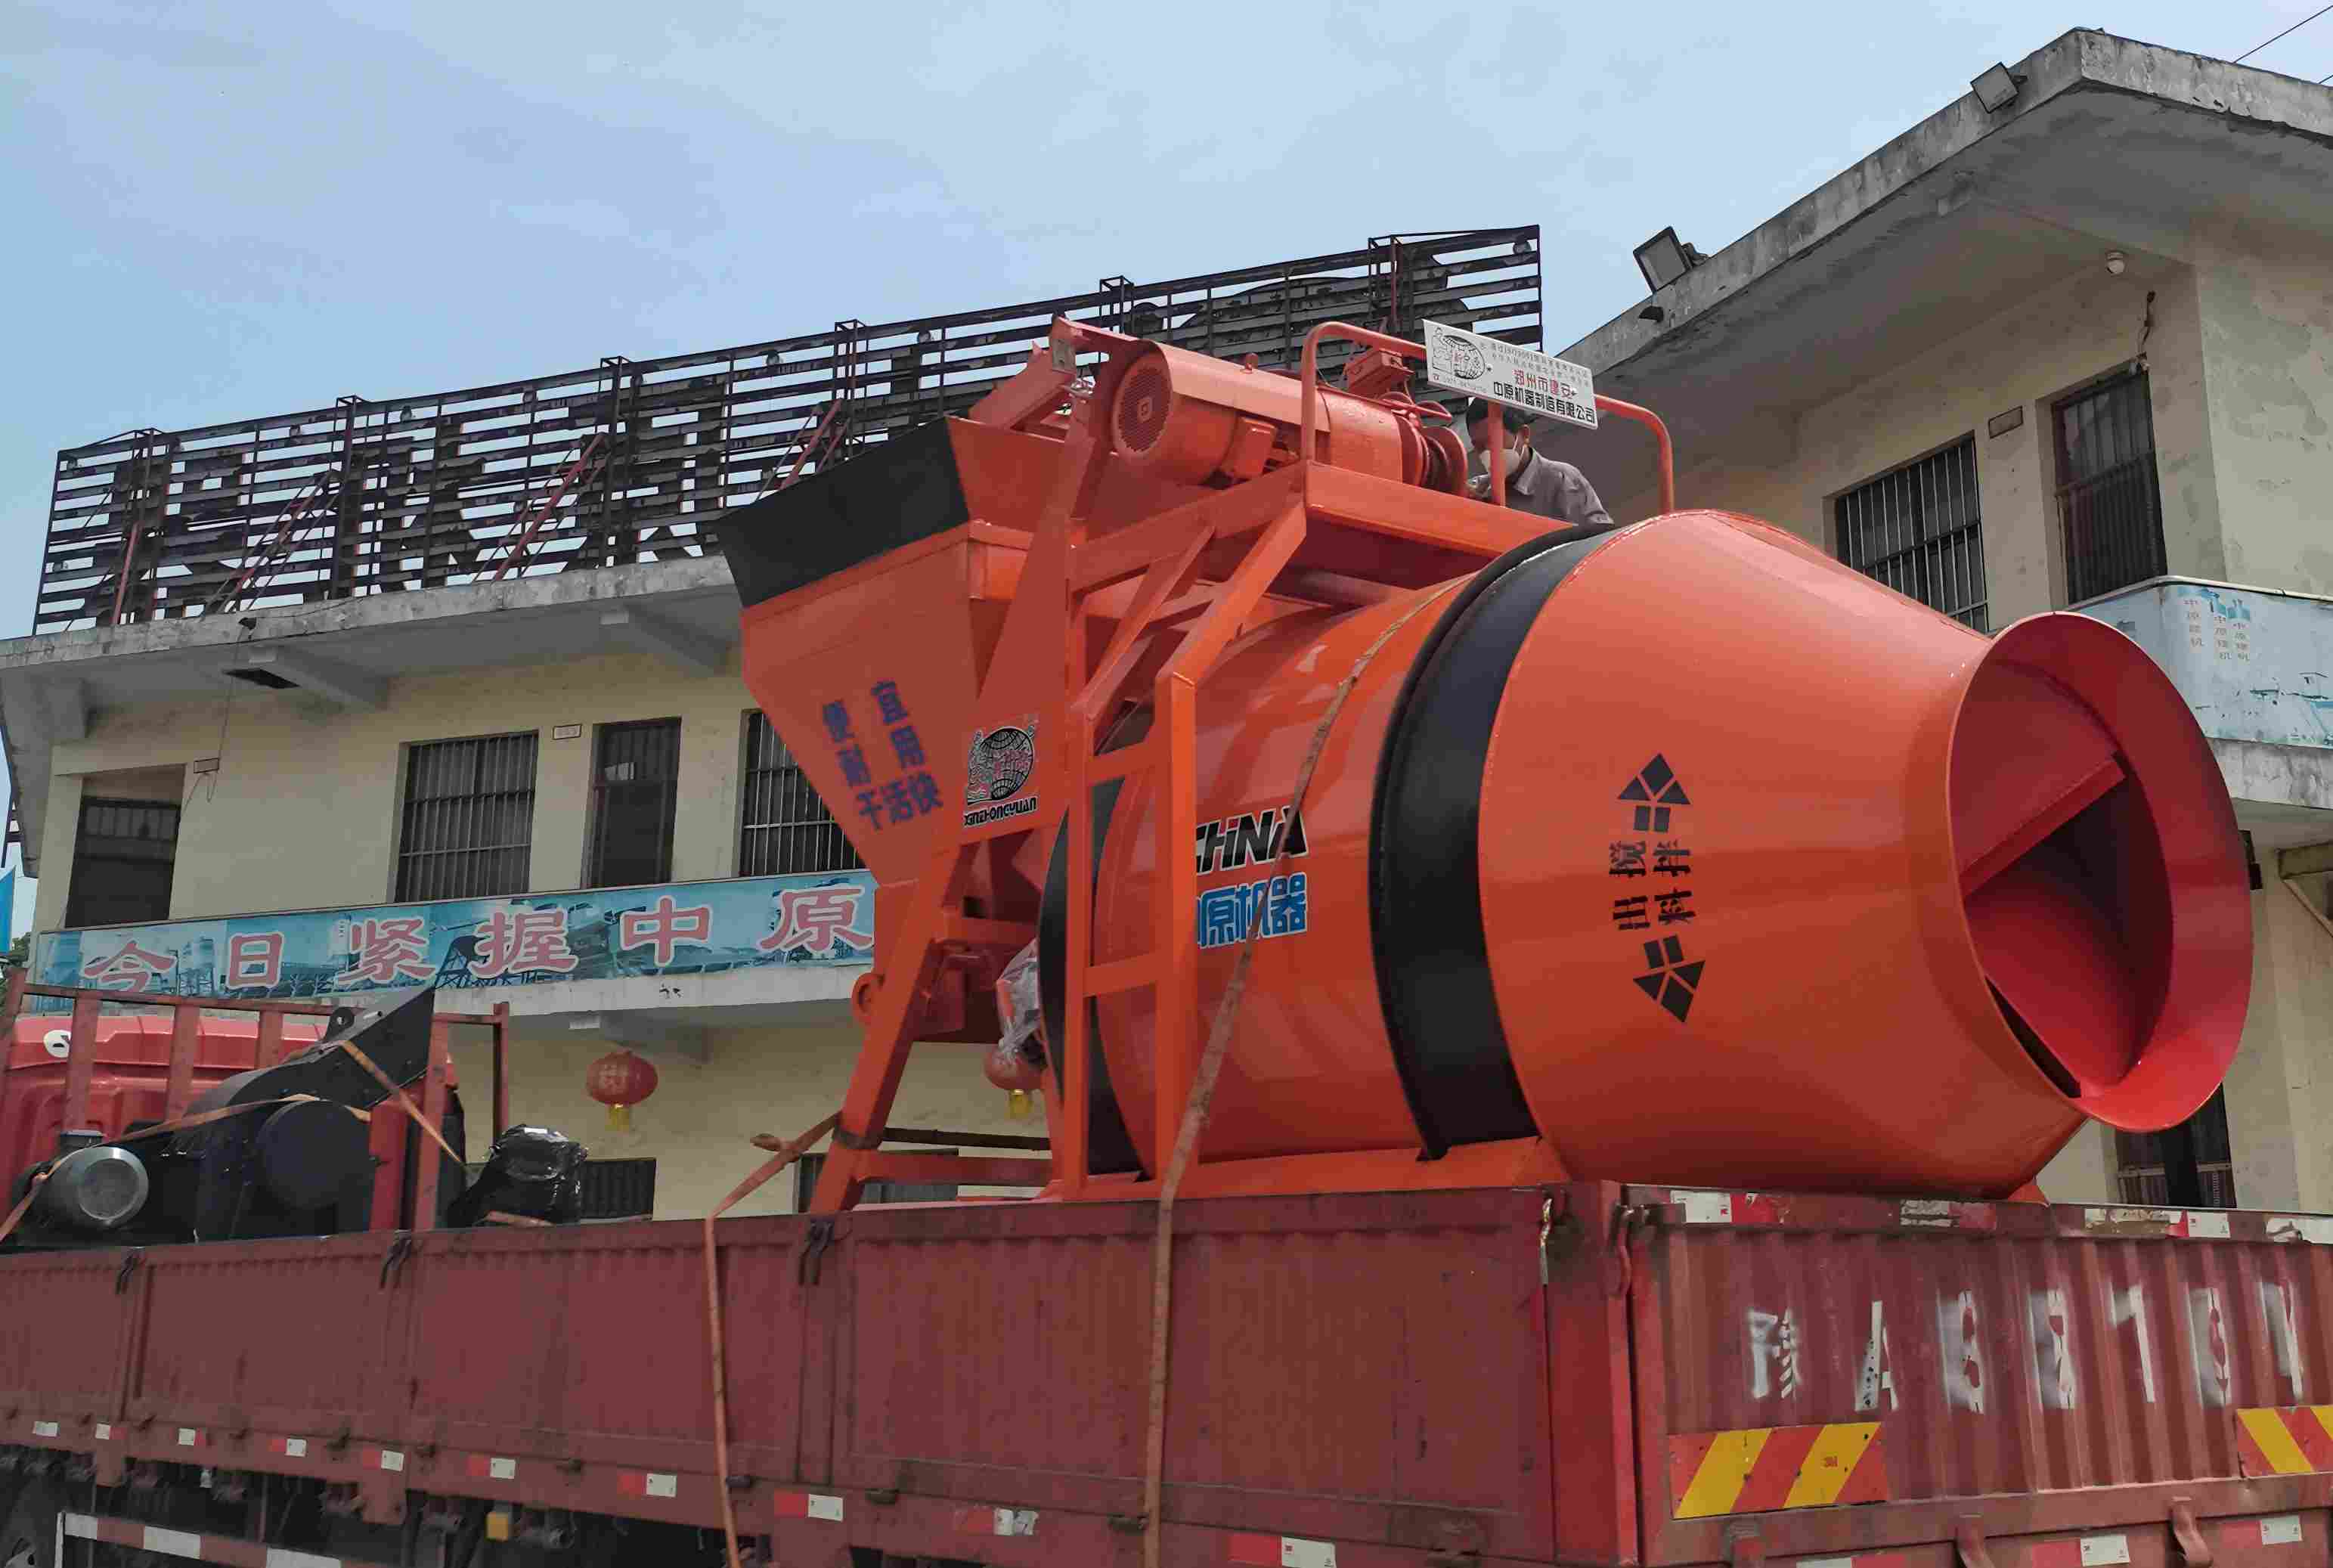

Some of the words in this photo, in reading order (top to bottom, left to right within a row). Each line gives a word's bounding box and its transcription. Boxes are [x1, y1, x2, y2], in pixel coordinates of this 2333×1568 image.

[80, 887, 874, 993] 今日紧握中原
[1197, 872, 1307, 949] 原机器
